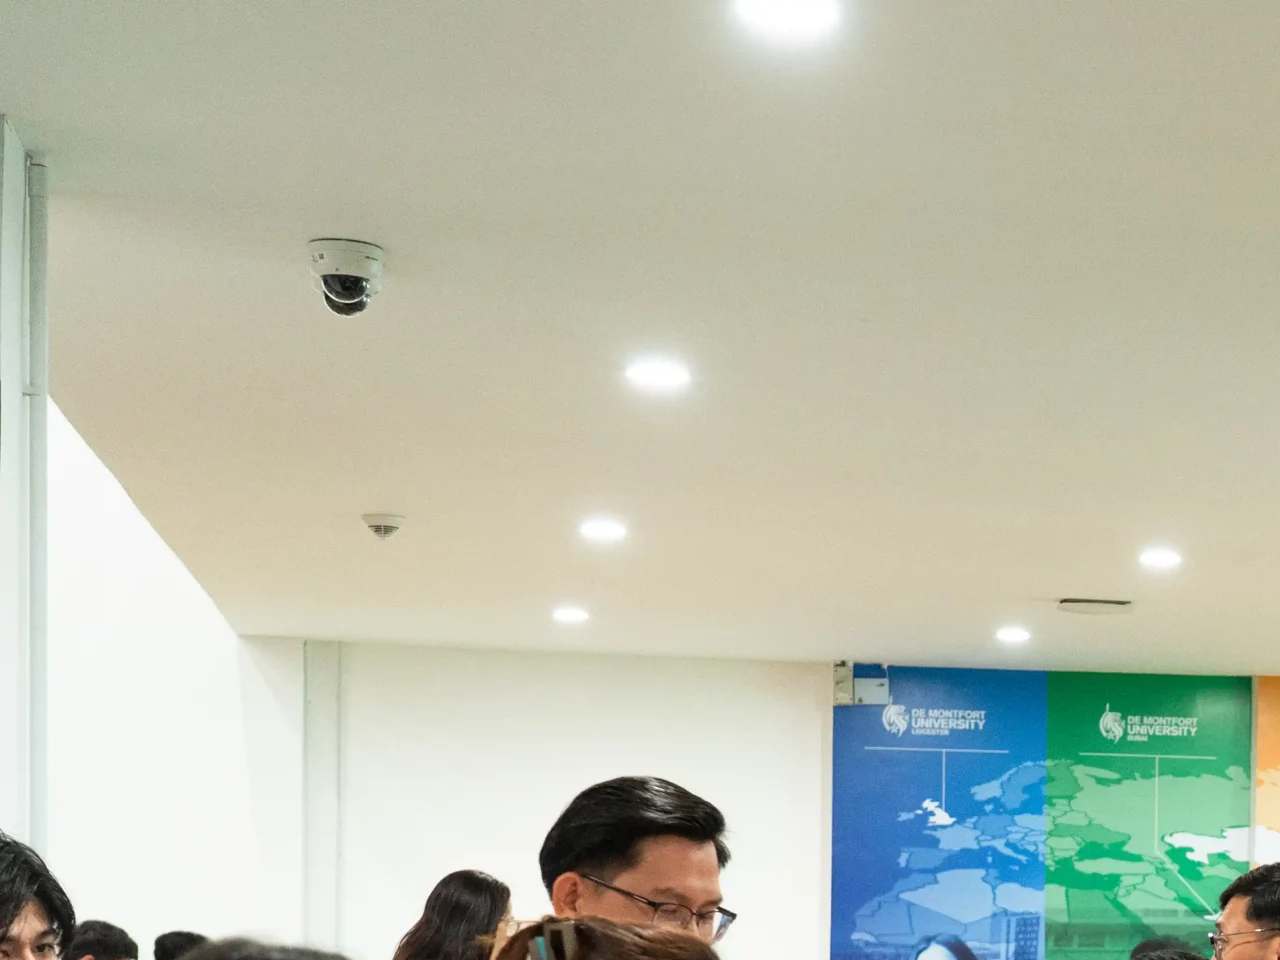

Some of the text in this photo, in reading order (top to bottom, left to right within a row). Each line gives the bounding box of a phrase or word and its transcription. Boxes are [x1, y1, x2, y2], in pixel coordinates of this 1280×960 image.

[911, 708, 986, 719] DE MONTFORT
[911, 718, 986, 730] UNIVERSITY
[1127, 716, 1198, 727] DE MONTFORT
[1127, 725, 1198, 736] UNIVERSITY
